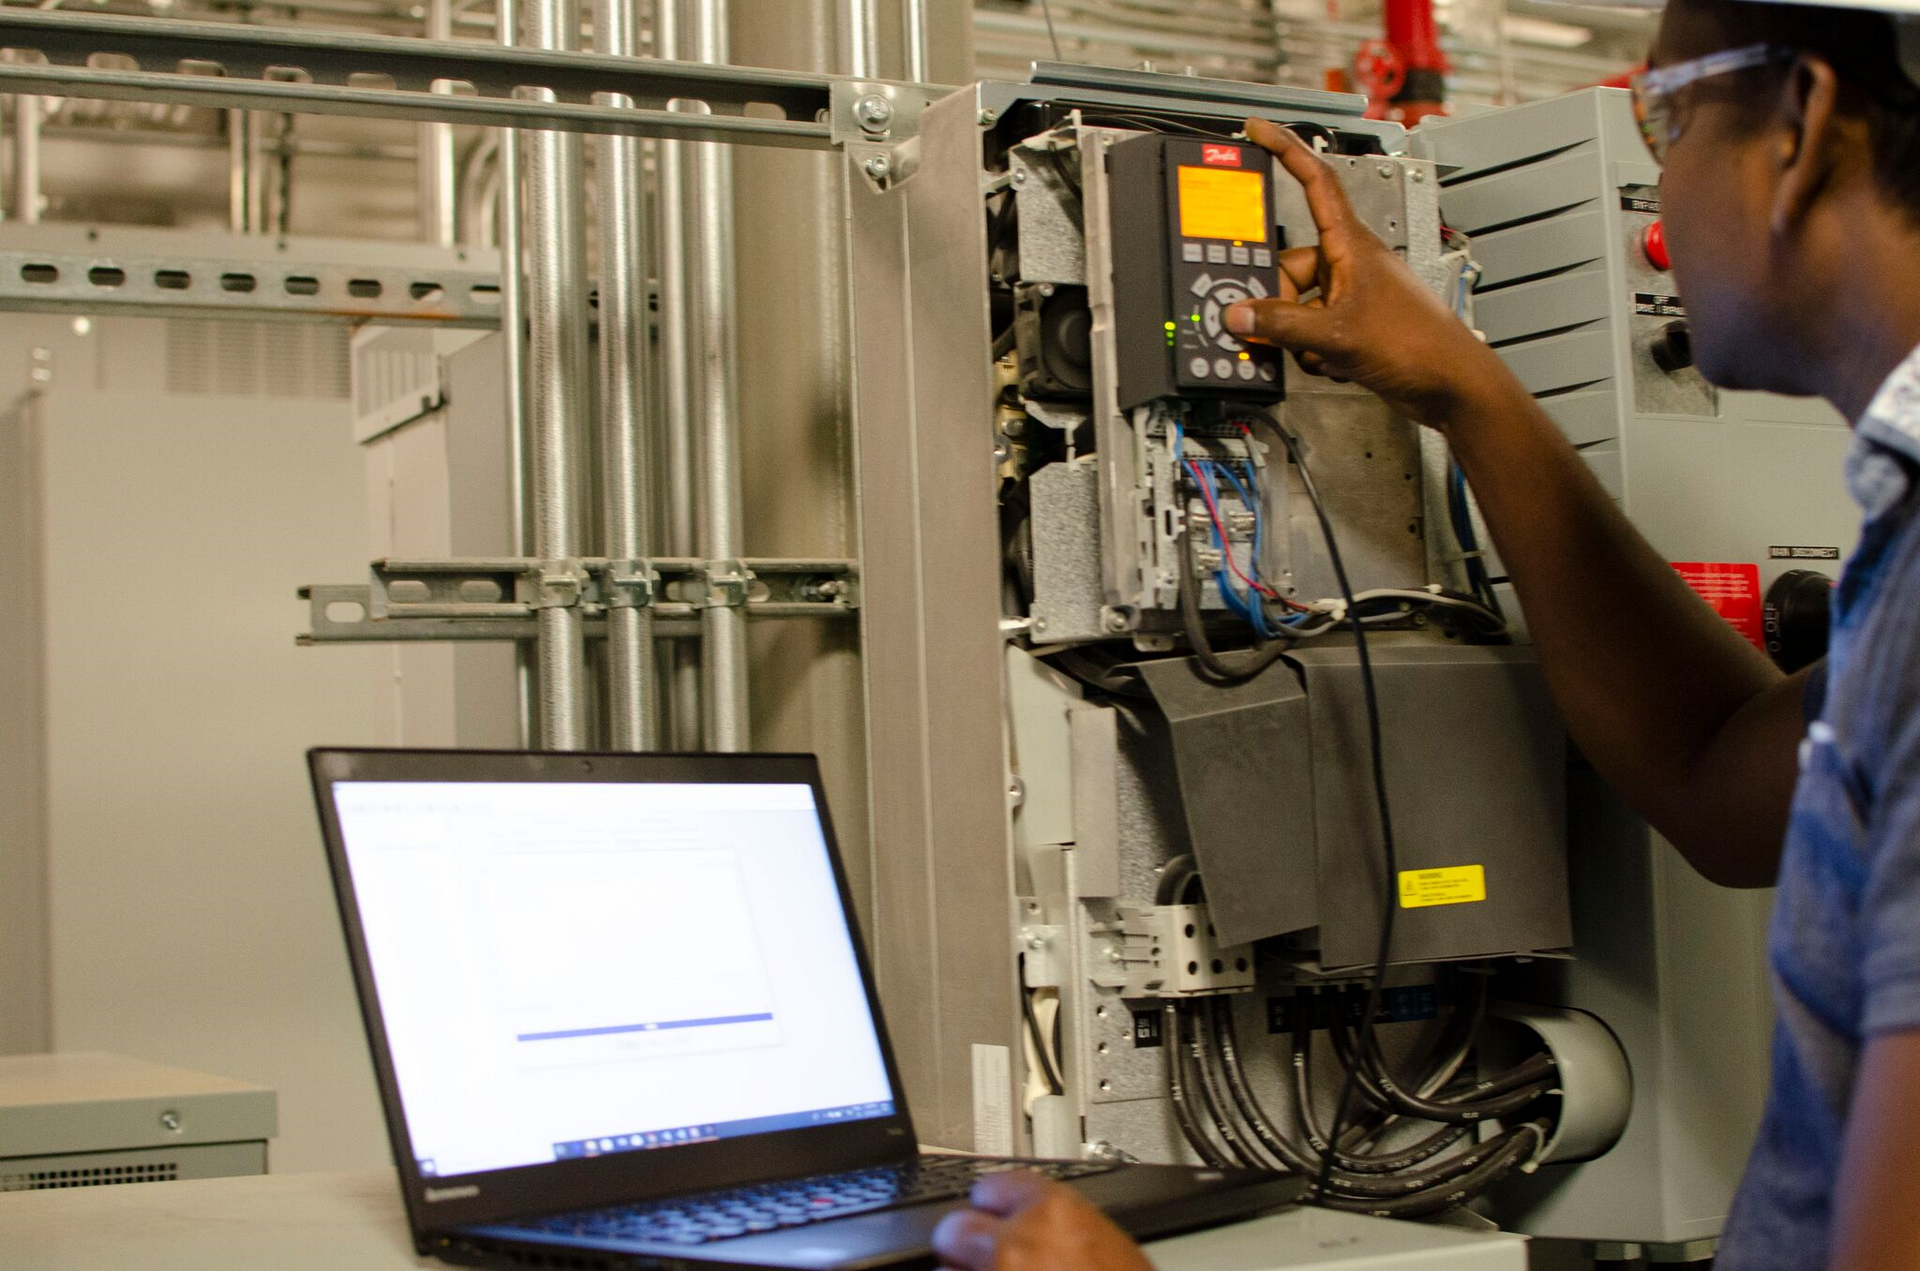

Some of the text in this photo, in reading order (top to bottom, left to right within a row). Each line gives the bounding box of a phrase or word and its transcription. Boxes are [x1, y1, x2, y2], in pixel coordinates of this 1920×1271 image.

[1631, 199, 1660, 211] BYPAS
[1771, 547, 1837, 558] MAIN DISCONNECT
